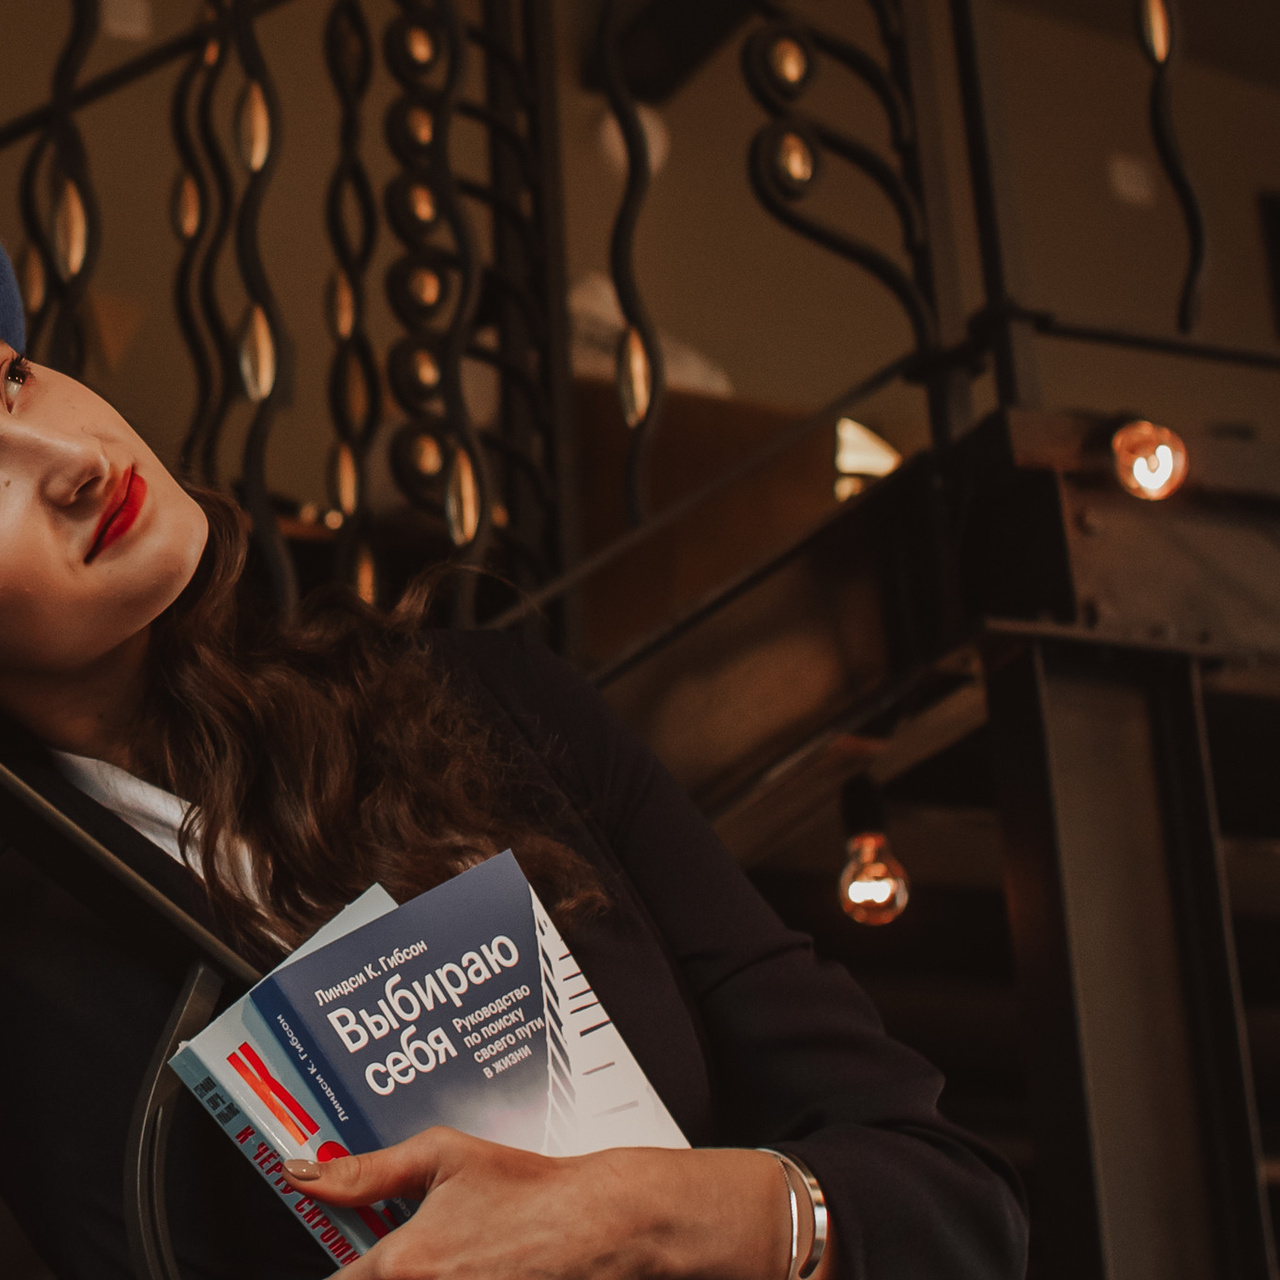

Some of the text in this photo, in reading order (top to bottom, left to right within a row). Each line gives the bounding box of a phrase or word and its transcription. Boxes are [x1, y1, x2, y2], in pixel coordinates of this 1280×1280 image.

[314, 940, 428, 1006] Линдси К. Гибсон
[327, 935, 519, 1053] Выбираю
[452, 984, 531, 1033] Руководство
[463, 1007, 525, 1048] по поиску
[277, 1014, 308, 1060] Гибсон
[365, 1024, 458, 1095] себя
[473, 1017, 545, 1063] своего пути
[307, 1060, 317, 1074] К.
[483, 1045, 532, 1079] в жизни
[315, 1074, 349, 1122] Линдси
[235, 1125, 256, 1145] К
